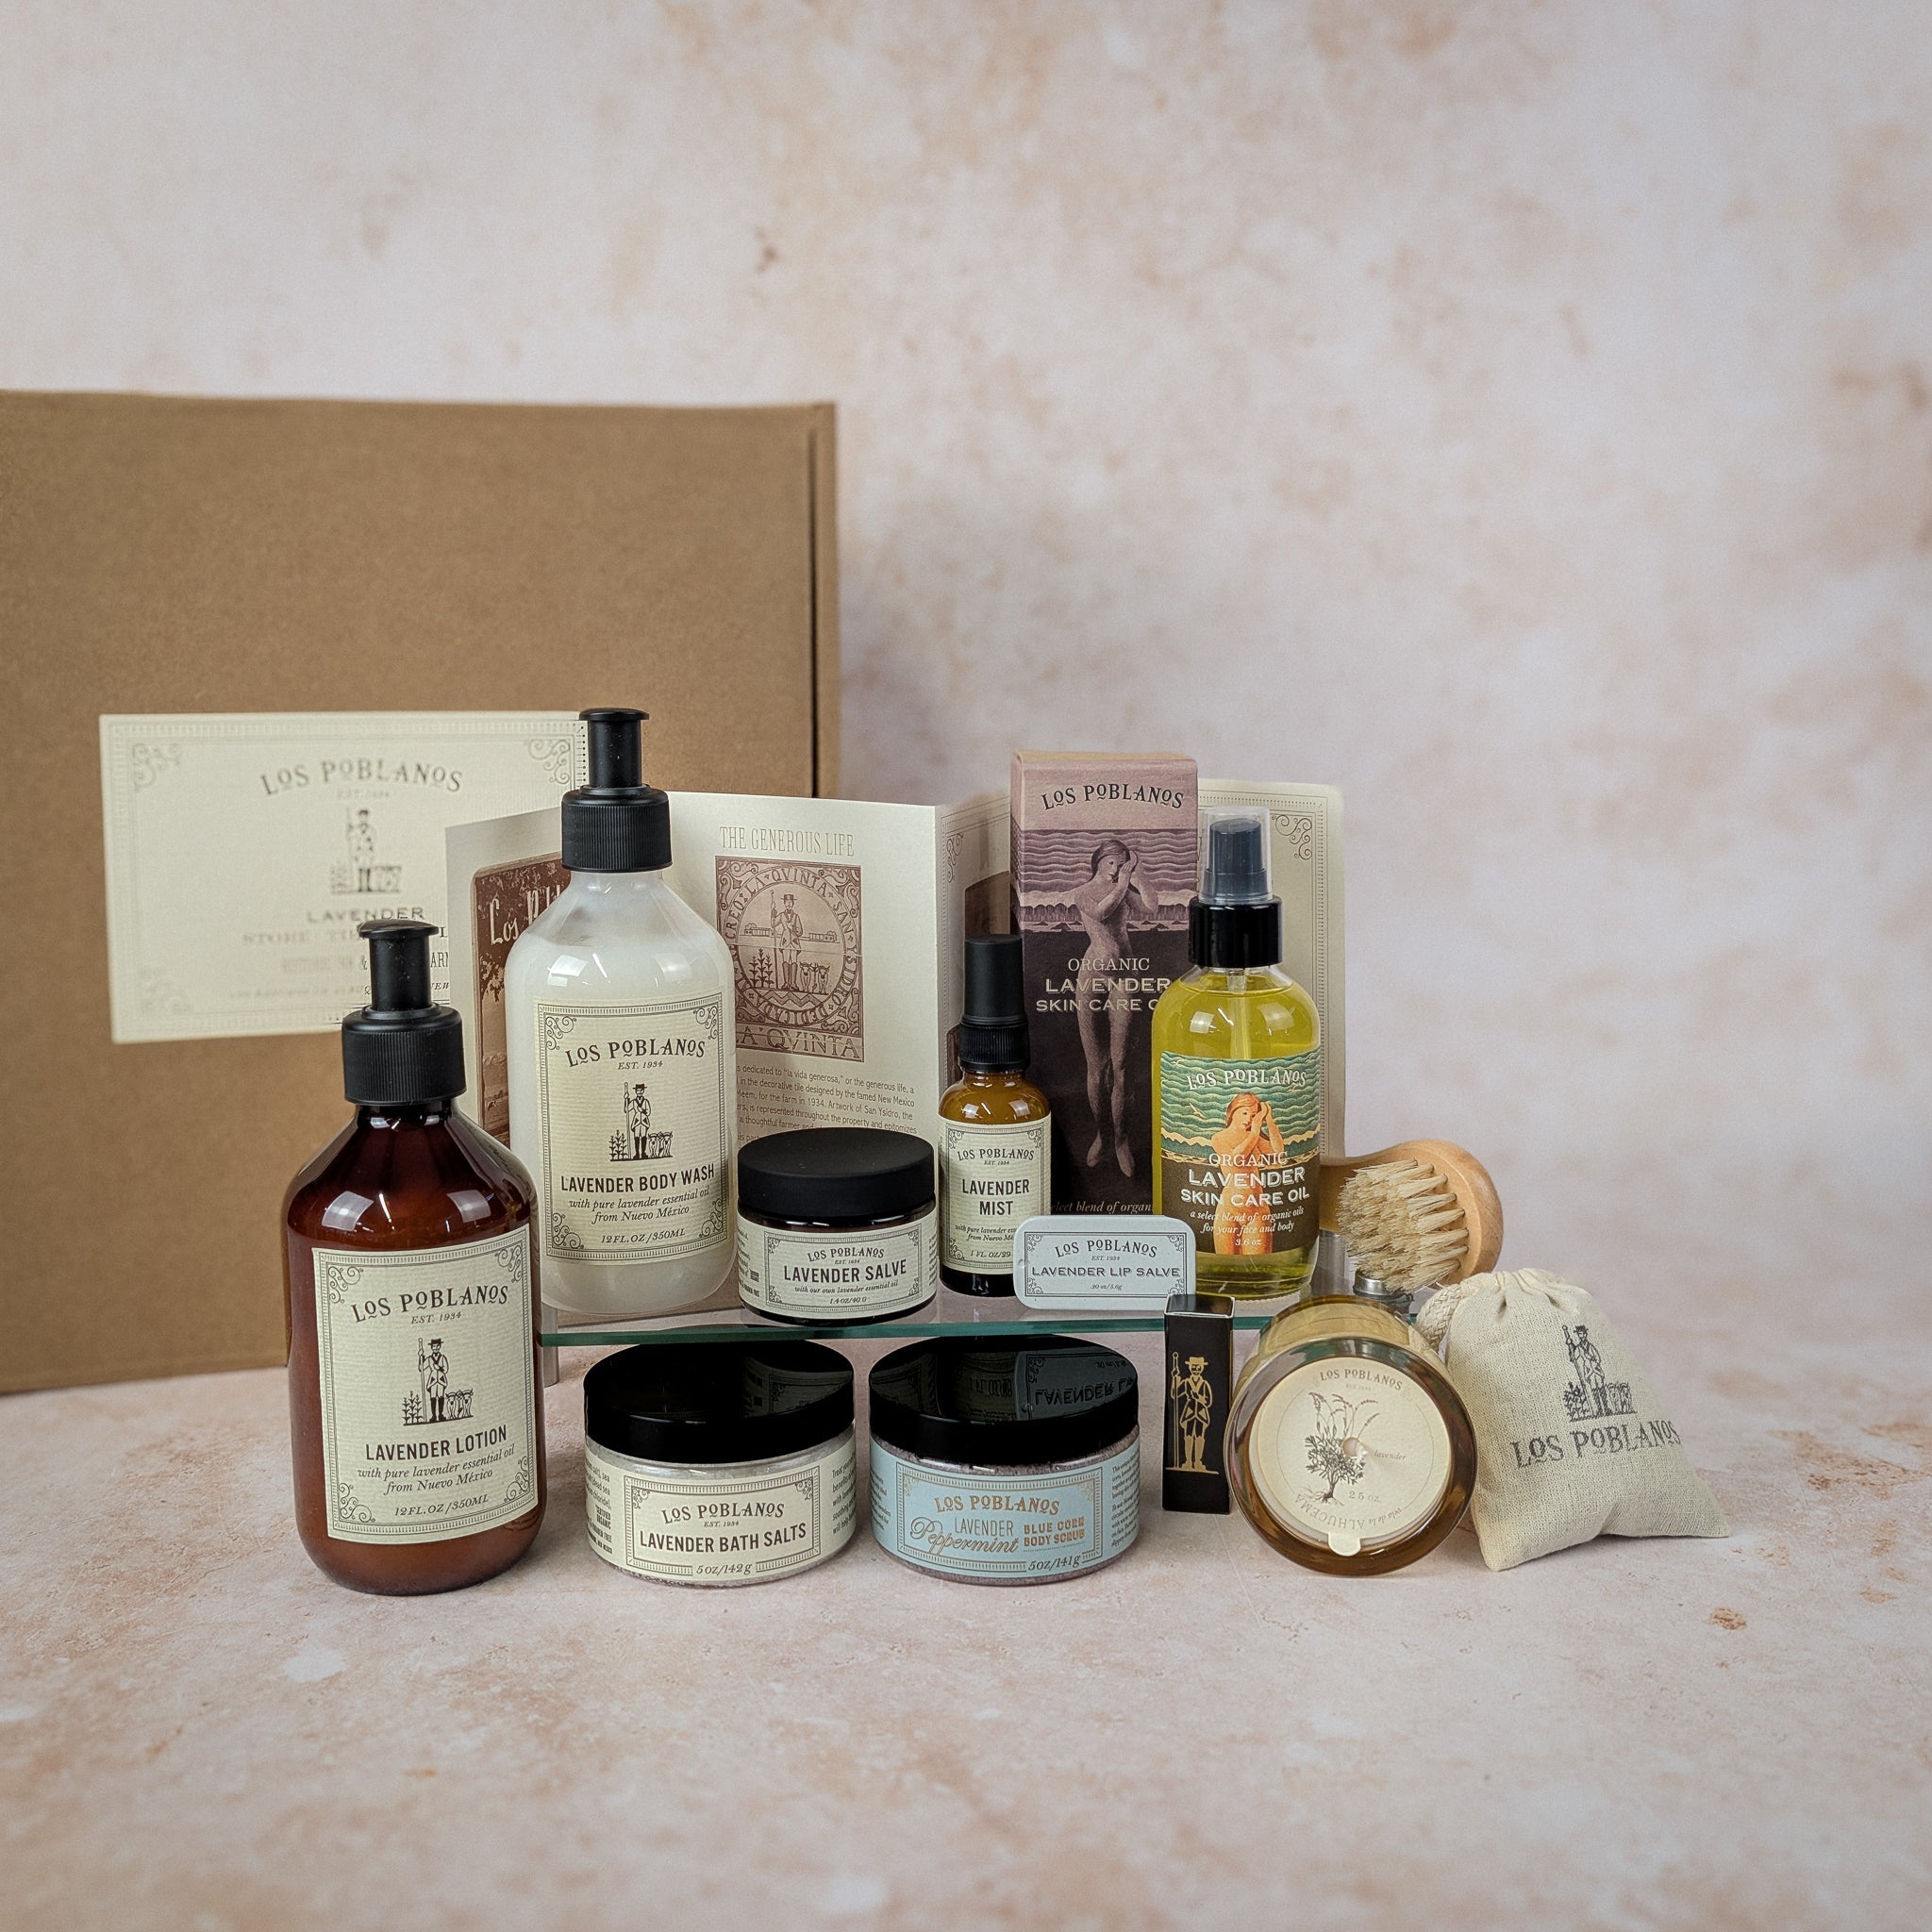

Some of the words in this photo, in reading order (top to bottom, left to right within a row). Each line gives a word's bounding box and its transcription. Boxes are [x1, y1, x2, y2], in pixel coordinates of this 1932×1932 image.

[260, 765, 309, 796] LOS
[321, 758, 462, 793] POBLANOS
[1041, 788, 1076, 810] LOS
[1083, 783, 1184, 809] POBLANOS
[720, 826, 747, 849] THE
[752, 828, 821, 853] GENEROUS
[825, 832, 855, 857] LIFE
[748, 875, 766, 896] LA
[772, 867, 828, 897] QVINTA
[834, 901, 855, 934] SAN
[308, 906, 426, 923] LAVENDER
[490, 897, 519, 945] Los
[1068, 958, 1151, 972] ORGANIC
[1045, 977, 1172, 994] LAVENDER
[1036, 999, 1081, 1011] SKIN
[1089, 998, 1143, 1011] CARE
[565, 1044, 601, 1068] LOS
[608, 1038, 706, 1058] POBLANOS
[766, 1028, 860, 1058] QVINTA
[618, 1060, 639, 1070] EST.
[642, 1060, 663, 1069] 1934
[743, 1065, 774, 1075] dedicated
[794, 1071, 808, 1079] vida
[855, 1077, 864, 1087] the
[866, 1081, 895, 1091] generous
[897, 1083, 908, 1094] life,
[1187, 1072, 1219, 1091] LOS
[1224, 1069, 1307, 1087] POBLANOS
[747, 1077, 758, 1086] the
[760, 1079, 792, 1091] decorative
[794, 1083, 804, 1091] tile
[806, 1085, 834, 1096] designed
[836, 1088, 843, 1098] by
[845, 1090, 855, 1098] the
[857, 1091, 875, 1102] famed
[878, 1094, 891, 1104] New
[893, 1096, 915, 1107] Mexico
[757, 1106, 793, 1116] represented
[796, 1109, 829, 1122] throughout
[831, 1113, 841, 1123] the
[843, 1117, 869, 1126] property
[758, 1091, 767, 1100] for
[770, 1093, 779, 1102] the
[783, 1094, 796, 1104] farm
[799, 1096, 805, 1105] in
[808, 1098, 826, 1108] 1934.
[828, 1100, 854, 1111] Artwork
[856, 1105, 862, 1113] of
[864, 1106, 876, 1115] San
[879, 1107, 900, 1119] Ysidro,
[903, 1111, 913, 1121] the
[745, 1116, 777, 1127] thoughtful
[957, 1149, 975, 1160] LOS
[979, 1148, 1034, 1160] POBLANOS
[1209, 1151, 1288, 1167] ORGANIC
[561, 1175, 634, 1192] LAVENDER
[639, 1173, 677, 1191] BODY
[681, 1163, 715, 1185] WASH
[962, 1179, 1030, 1196] LAVENDER
[1189, 1166, 1306, 1189] LAVENDER
[569, 1199, 590, 1208] with
[592, 1200, 614, 1211] pure
[618, 1196, 658, 1208] lavender
[662, 1189, 698, 1205] essential
[700, 1186, 709, 1198] oil
[979, 1200, 1013, 1215] MIST
[1076, 1201, 1104, 1212] blend
[1108, 1202, 1118, 1214] of
[1181, 1189, 1224, 1206] SKIN
[1230, 1191, 1283, 1208] CARE
[1288, 1187, 1310, 1202] OIL
[592, 1211, 618, 1224] from
[621, 1210, 653, 1222] Nuevo
[656, 1205, 690, 1219] México
[1197, 1211, 1217, 1221] select
[1221, 1211, 1245, 1222] blend
[1247, 1212, 1258, 1223] of
[1262, 1208, 1292, 1223] organic
[1293, 1206, 1304, 1216] oils
[966, 1226, 979, 1235] pure
[1200, 1223, 1215, 1234] for
[1218, 1226, 1238, 1236] your
[1239, 1223, 1257, 1236] face
[1260, 1223, 1275, 1234] and
[1277, 1221, 1294, 1232] body
[808, 1250, 826, 1262] LOS
[830, 1247, 885, 1258] POBLANOS
[1055, 1241, 1079, 1258] LOS
[1087, 1240, 1158, 1258] POBLANOS
[784, 1266, 860, 1283] LAVENDER
[865, 1259, 906, 1281] SALVE
[1032, 1267, 1106, 1277] LAVENDER
[1110, 1267, 1132, 1276] LIP
[1136, 1267, 1180, 1277] SALVE
[865, 1281, 890, 1291] essential
[351, 1297, 391, 1323] LOS
[400, 1285, 509, 1313] POBLANOS
[411, 1314, 434, 1324] EST.
[440, 1311, 461, 1322] 1934
[1320, 1369, 1341, 1381] LOS
[1344, 1369, 1403, 1391] POBLANOS
[366, 1440, 450, 1461] LAVENDER
[455, 1424, 508, 1454] LOTION
[1509, 1435, 1564, 1469] LOS
[1570, 1420, 1681, 1458] POBLANOS
[358, 1466, 381, 1479] with
[385, 1468, 408, 1481] pure
[412, 1460, 459, 1477] lavender
[462, 1451, 502, 1470] essential
[504, 1443, 515, 1458] oil
[1374, 1449, 1406, 1460] lavender
[384, 1480, 413, 1495] from
[417, 1477, 453, 1491] Nuevo
[456, 1469, 492, 1487] México
[661, 1506, 691, 1524] LOS
[697, 1501, 785, 1518] POBLANOS
[934, 1496, 964, 1514] LOS
[970, 1495, 1060, 1515] POBLANOS
[1295, 1493, 1366, 1530] ALHUCEMA
[1388, 1507, 1402, 1521] vela
[955, 1516, 1014, 1536] LAVENDER
[1024, 1523, 1053, 1534] BLUE
[1057, 1516, 1085, 1532] CORN
[1369, 1517, 1377, 1526] la
[640, 1530, 715, 1553] LAVENDER
[719, 1534, 759, 1552] BATH
[763, 1522, 808, 1547] SALTS
[910, 1516, 1019, 1556] Peppermint
[1024, 1534, 1051, 1547] BODY
[1053, 1528, 1086, 1543] SCRUB
